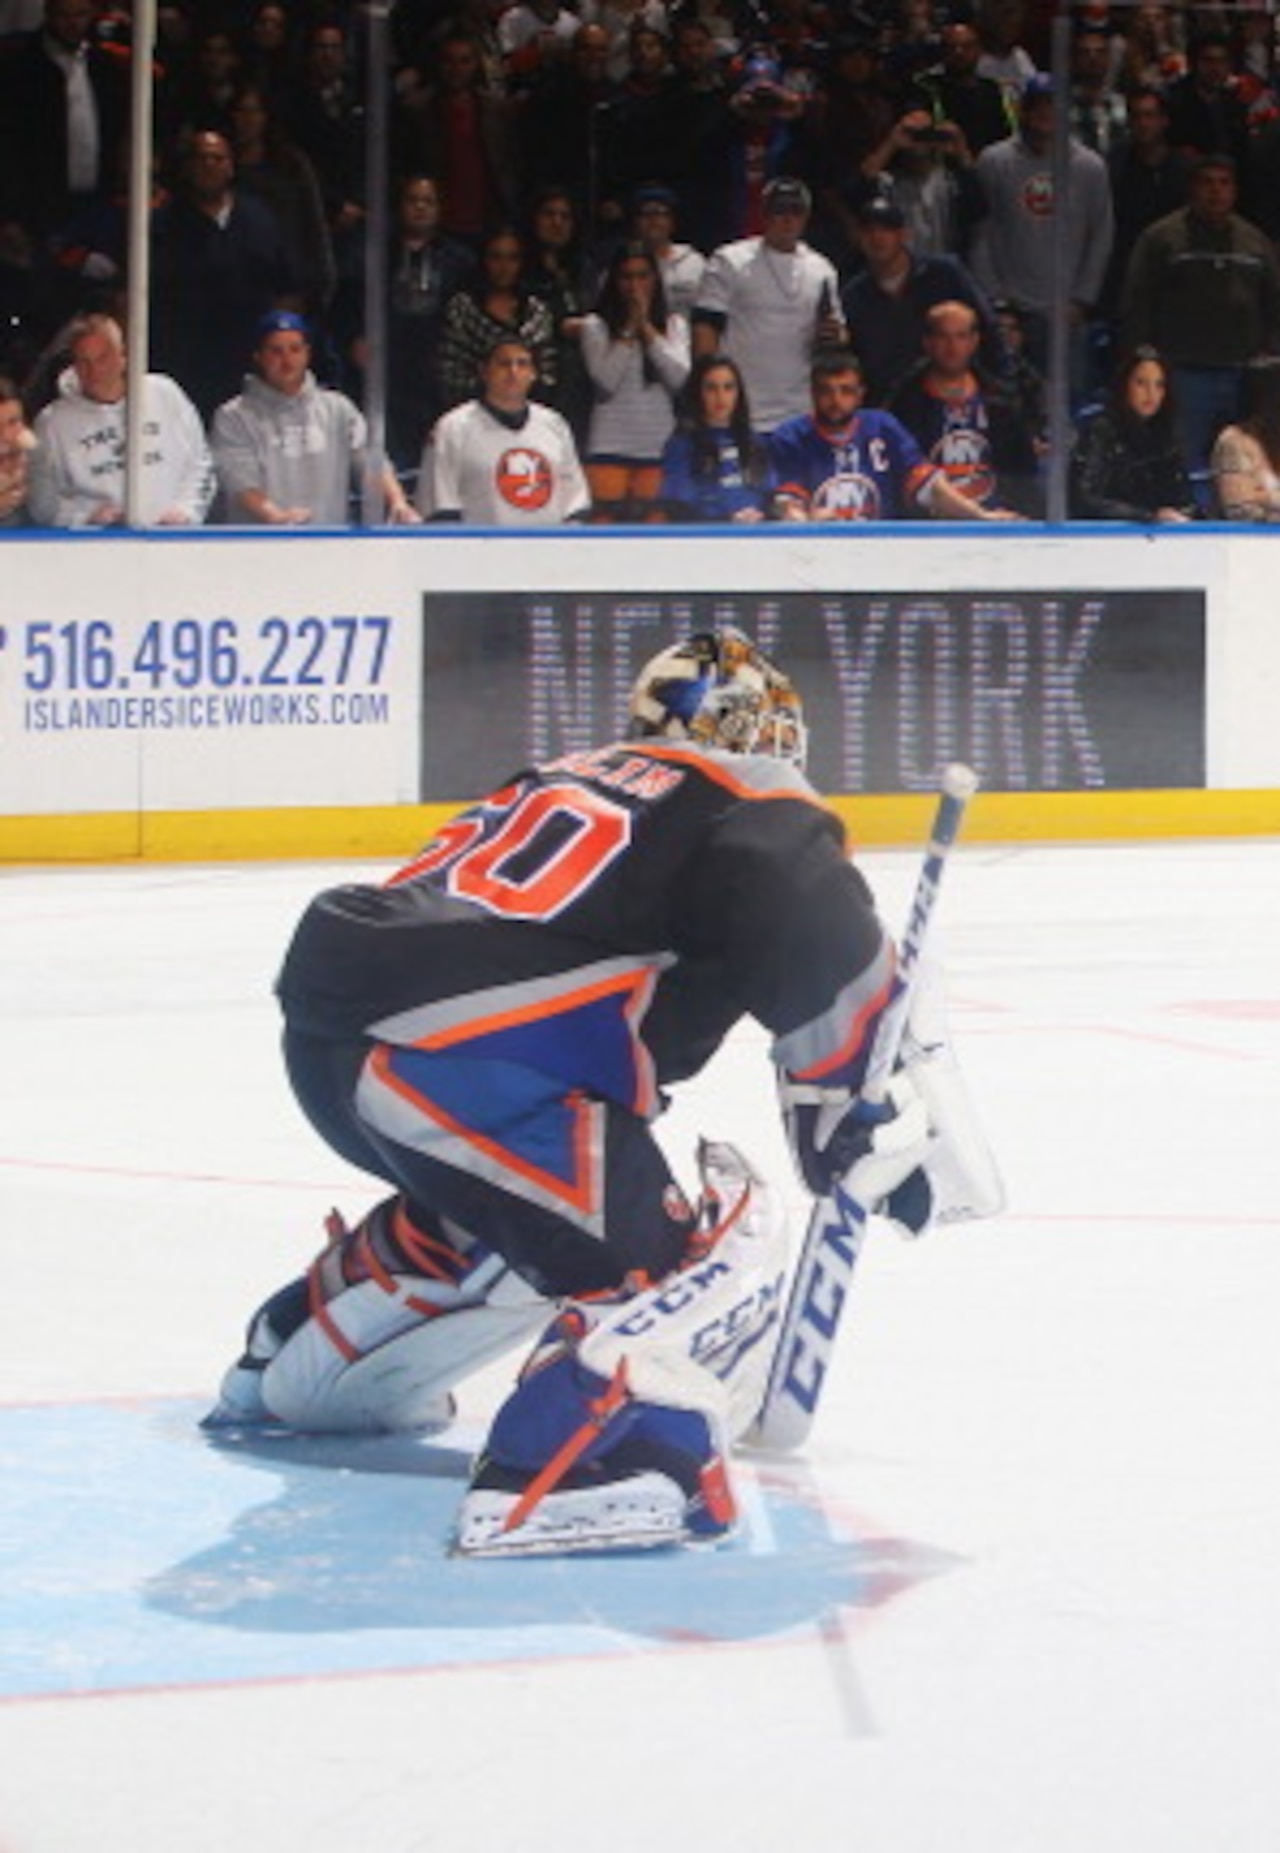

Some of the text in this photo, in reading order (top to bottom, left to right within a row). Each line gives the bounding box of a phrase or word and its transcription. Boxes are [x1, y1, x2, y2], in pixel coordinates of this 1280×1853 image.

[868, 438, 889, 472] C
[24, 616, 392, 692] 516.496.2277
[24, 693, 389, 732] ISLANDERSICEWORKS.COM
[822, 600, 1105, 790] YORK
[611, 1261, 732, 1336] CCM
[783, 1182, 868, 1415] CCM
